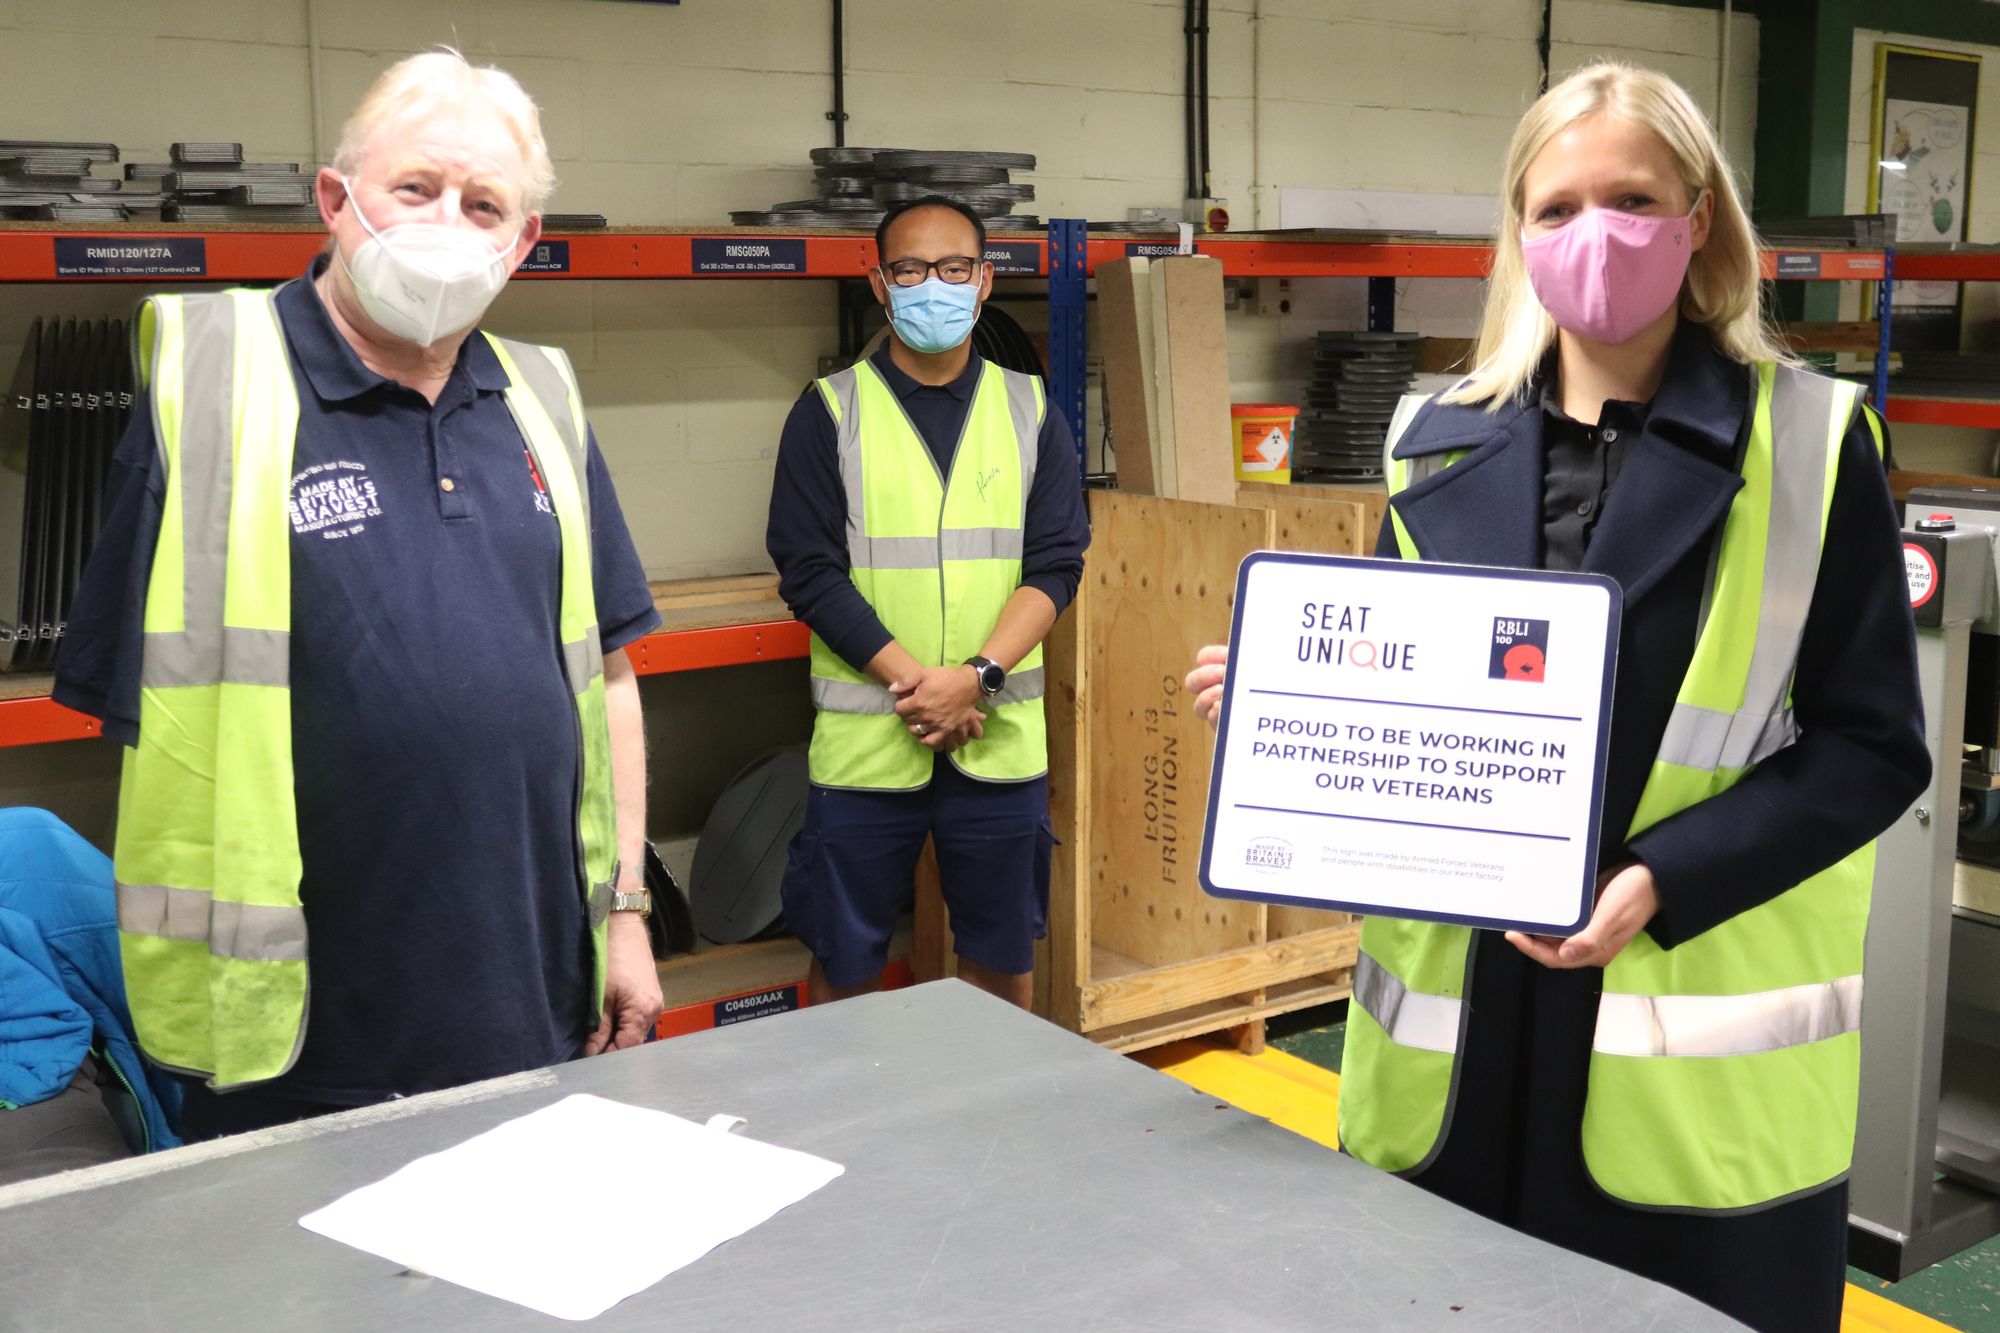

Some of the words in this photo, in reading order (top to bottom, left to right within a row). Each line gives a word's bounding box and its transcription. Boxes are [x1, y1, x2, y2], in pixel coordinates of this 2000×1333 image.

[87, 248, 172, 258] RMID120/127A
[726, 246, 770, 257] RMSG050PA
[290, 481, 375, 513] BRITAIN'S
[299, 480, 337, 498] MADE
[338, 476, 355, 490] BY
[290, 493, 378, 525] BRAVEST
[1915, 571, 1930, 580] and
[1302, 602, 1371, 633] SEAT
[1496, 620, 1529, 636] RBLI
[1495, 636, 1513, 645] 100
[1298, 636, 1416, 671] UNIQUE
[1257, 717, 1338, 738] PROUD
[1345, 725, 1375, 742] TO
[1382, 728, 1412, 745] BE
[1420, 731, 1534, 756] WORKING
[1542, 742, 1565, 759] IN
[1252, 741, 1410, 770] PARTNERSHIP
[1417, 757, 1447, 774] TO
[1454, 760, 1566, 785] SUPPORT
[1315, 773, 1364, 792] OUR
[1372, 778, 1493, 804] VETERANS
[1162, 736, 1178, 884] FRUITION
[1246, 848, 1293, 860] BRITAIN'S
[1246, 854, 1292, 866] BRAVEST
[1412, 855, 1439, 865] Armed
[1441, 857, 1467, 867] Forces
[1475, 872, 1504, 882] factory
[725, 990, 784, 1012] C0450XAAX
